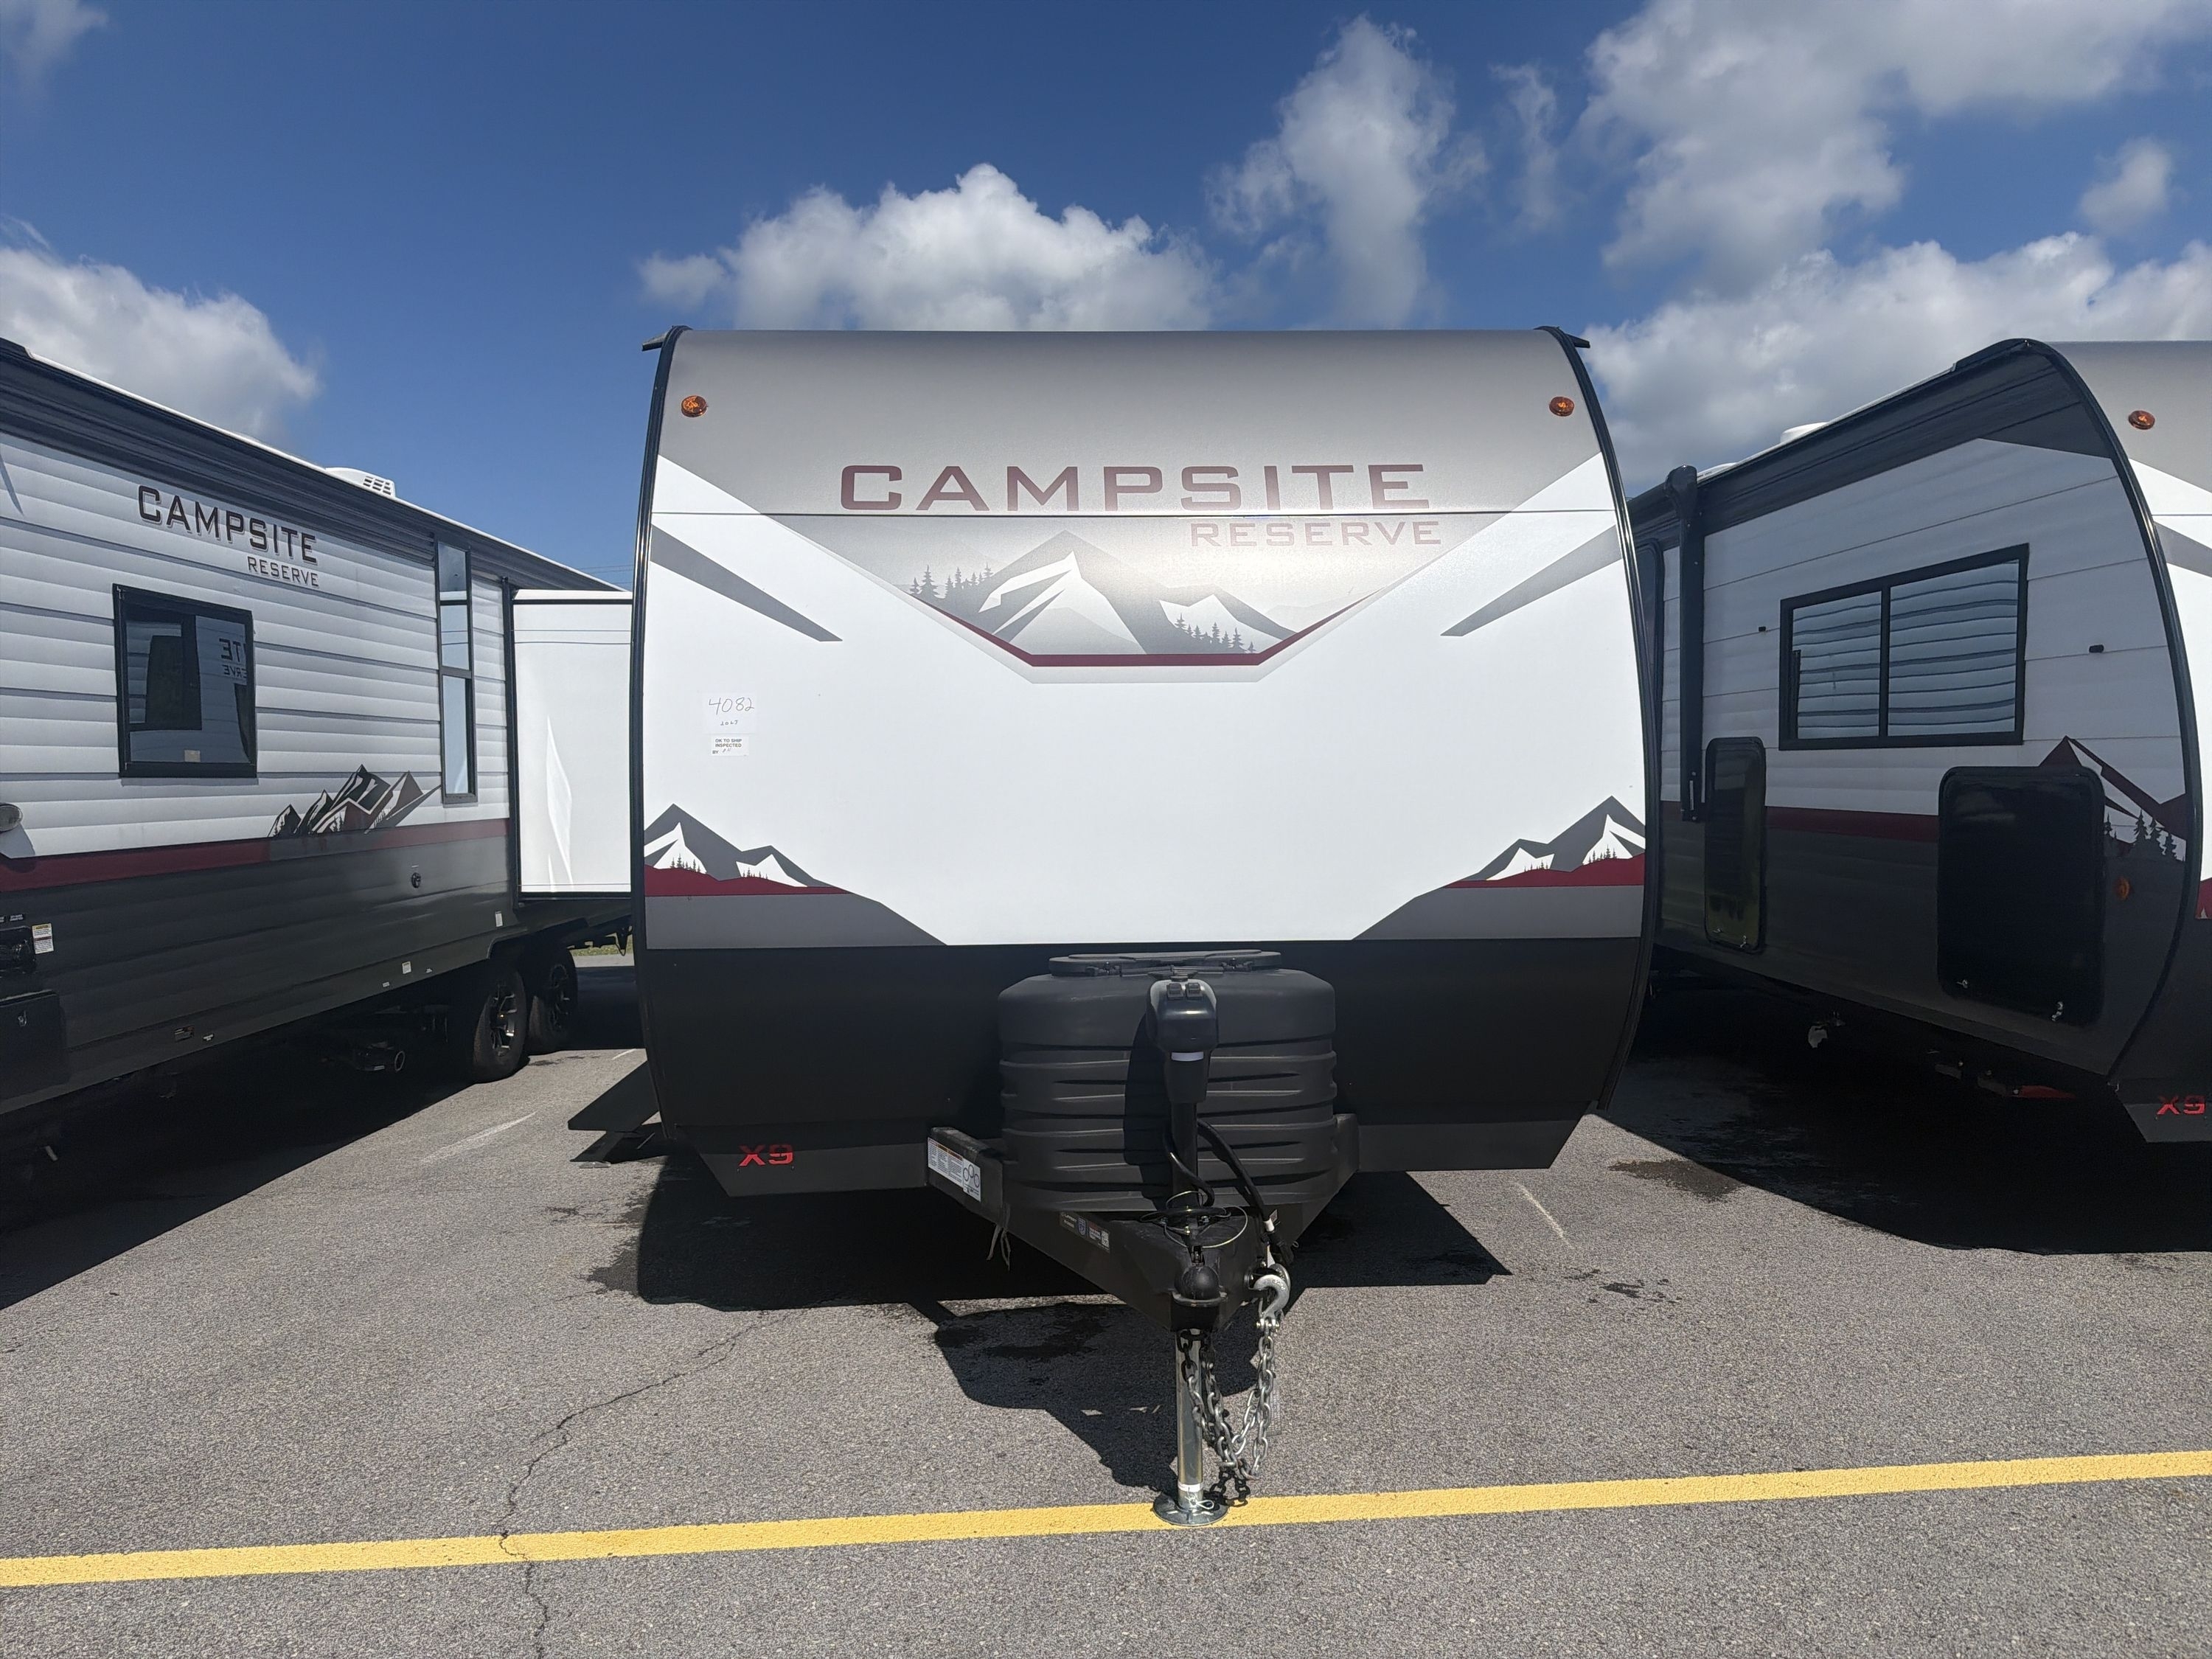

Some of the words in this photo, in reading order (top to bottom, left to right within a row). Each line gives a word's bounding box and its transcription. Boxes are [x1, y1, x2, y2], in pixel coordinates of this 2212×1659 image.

[841, 464, 1431, 512] CAMPSITE
[138, 485, 317, 563] CAMPSITE
[1191, 521, 1441, 547] RESERVE
[247, 555, 319, 587] RESERVE
[709, 697, 755, 715] 4082
[2157, 1094, 2206, 1115] X9
[739, 1144, 794, 1167] X9
